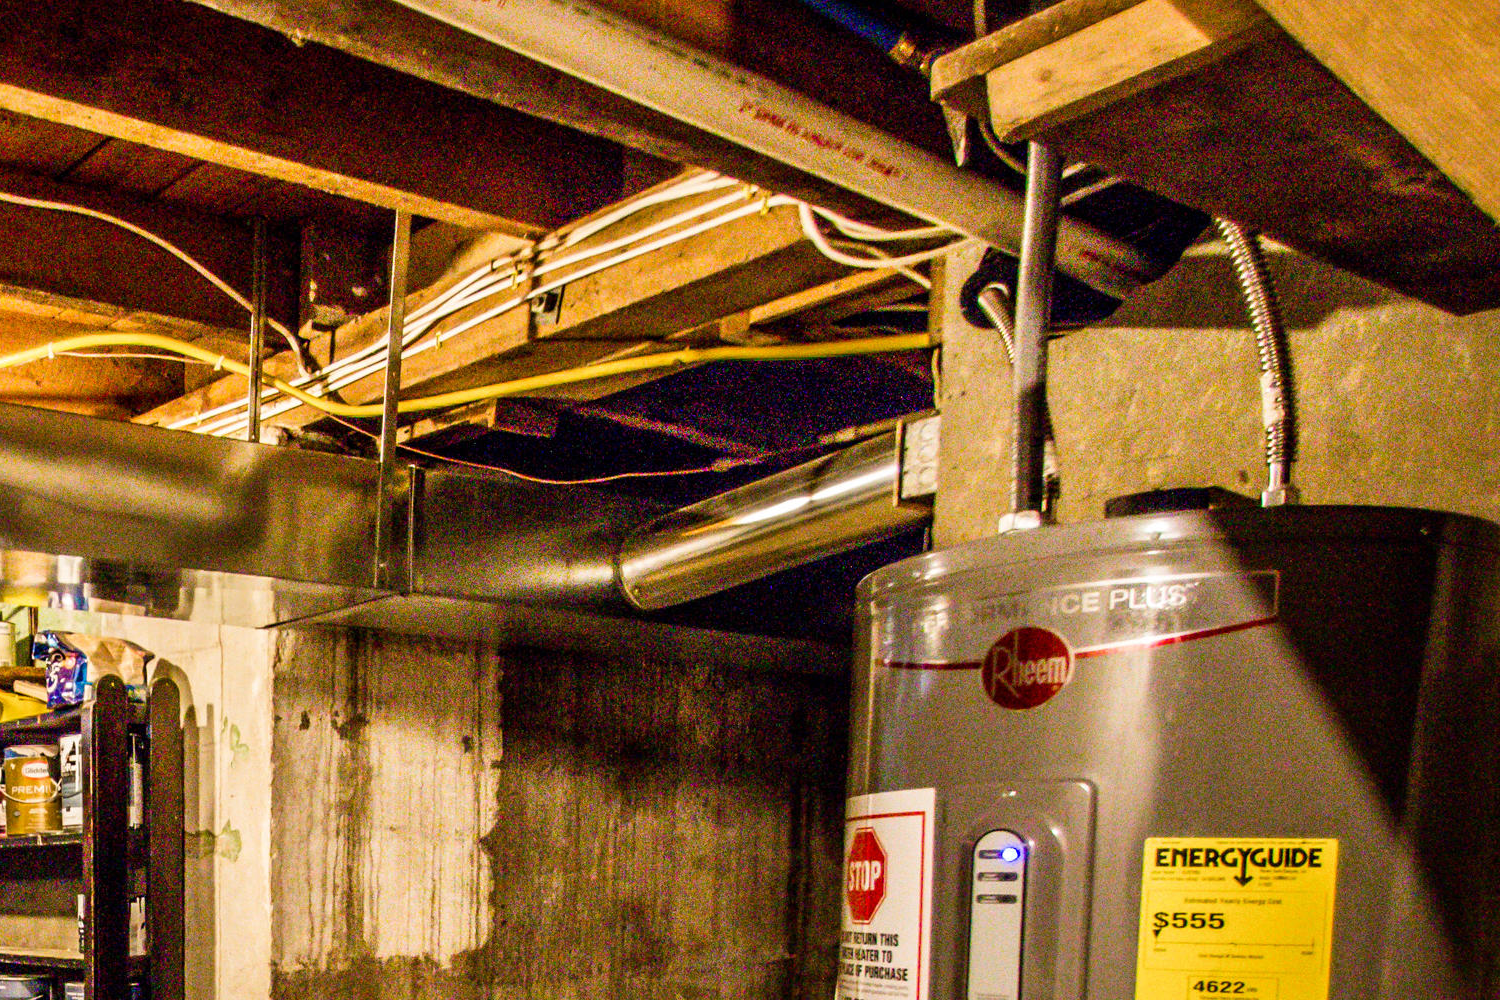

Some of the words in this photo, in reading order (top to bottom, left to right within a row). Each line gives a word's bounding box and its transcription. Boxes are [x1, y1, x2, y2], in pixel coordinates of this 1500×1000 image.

[1109, 584, 1188, 610] PLUS
[990, 630, 1067, 698] Rheem
[1155, 848, 1323, 877] ENERGYGUIDE
[848, 860, 882, 892] STOP
[1153, 912, 1225, 929] $555
[854, 932, 878, 946] RETURN
[880, 933, 899, 947] THIS
[882, 950, 893, 963] TO
[865, 966, 909, 982] PURCHASE
[1193, 980, 1245, 994] 4622
